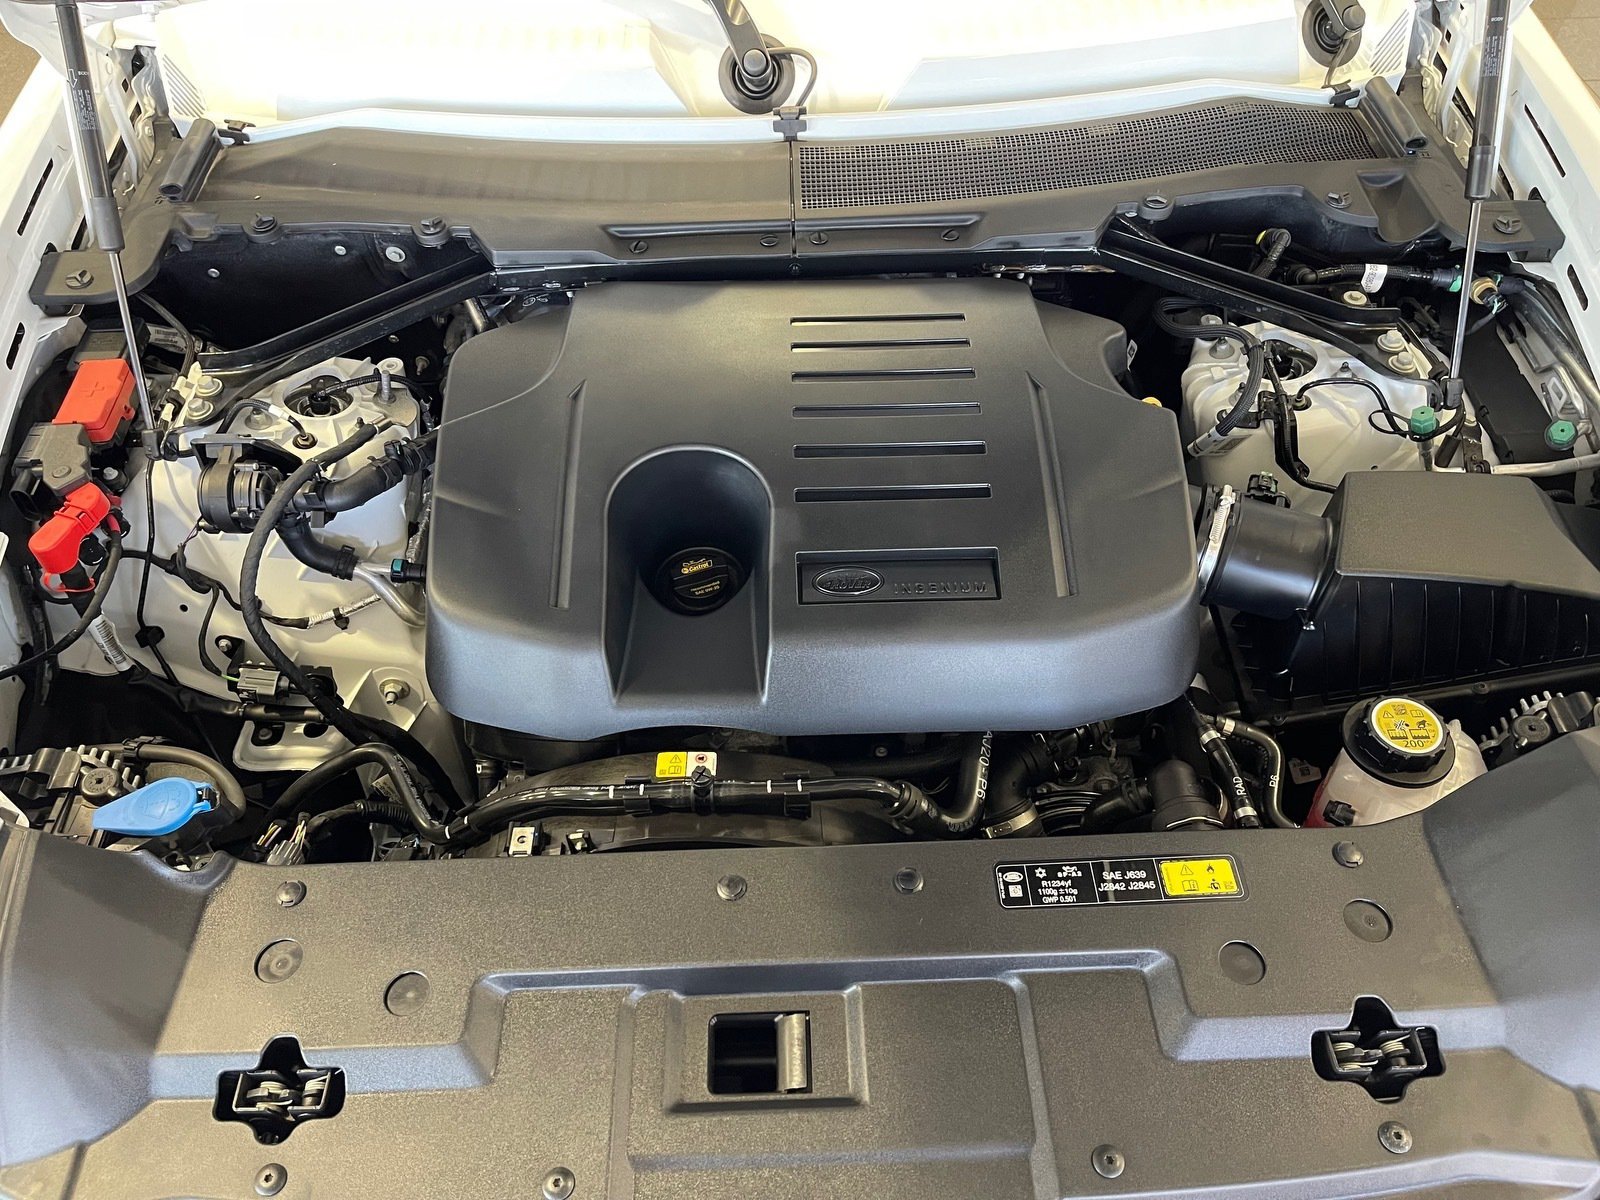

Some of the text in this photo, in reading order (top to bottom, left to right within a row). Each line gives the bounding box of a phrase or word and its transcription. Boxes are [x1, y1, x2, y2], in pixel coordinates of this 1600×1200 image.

[688, 561, 709, 572] Castrol
[894, 581, 988, 595] INGENIUM
[1403, 740, 1424, 748] 200
[1232, 776, 1247, 796] RAD
[1102, 870, 1147, 880] SAE J639
[1041, 880, 1072, 888] R1234yf
[1098, 881, 1156, 892] J2842 J2845
[1038, 887, 1078, 896] 1100g ±10g
[1042, 895, 1077, 904] GWP 0.501
